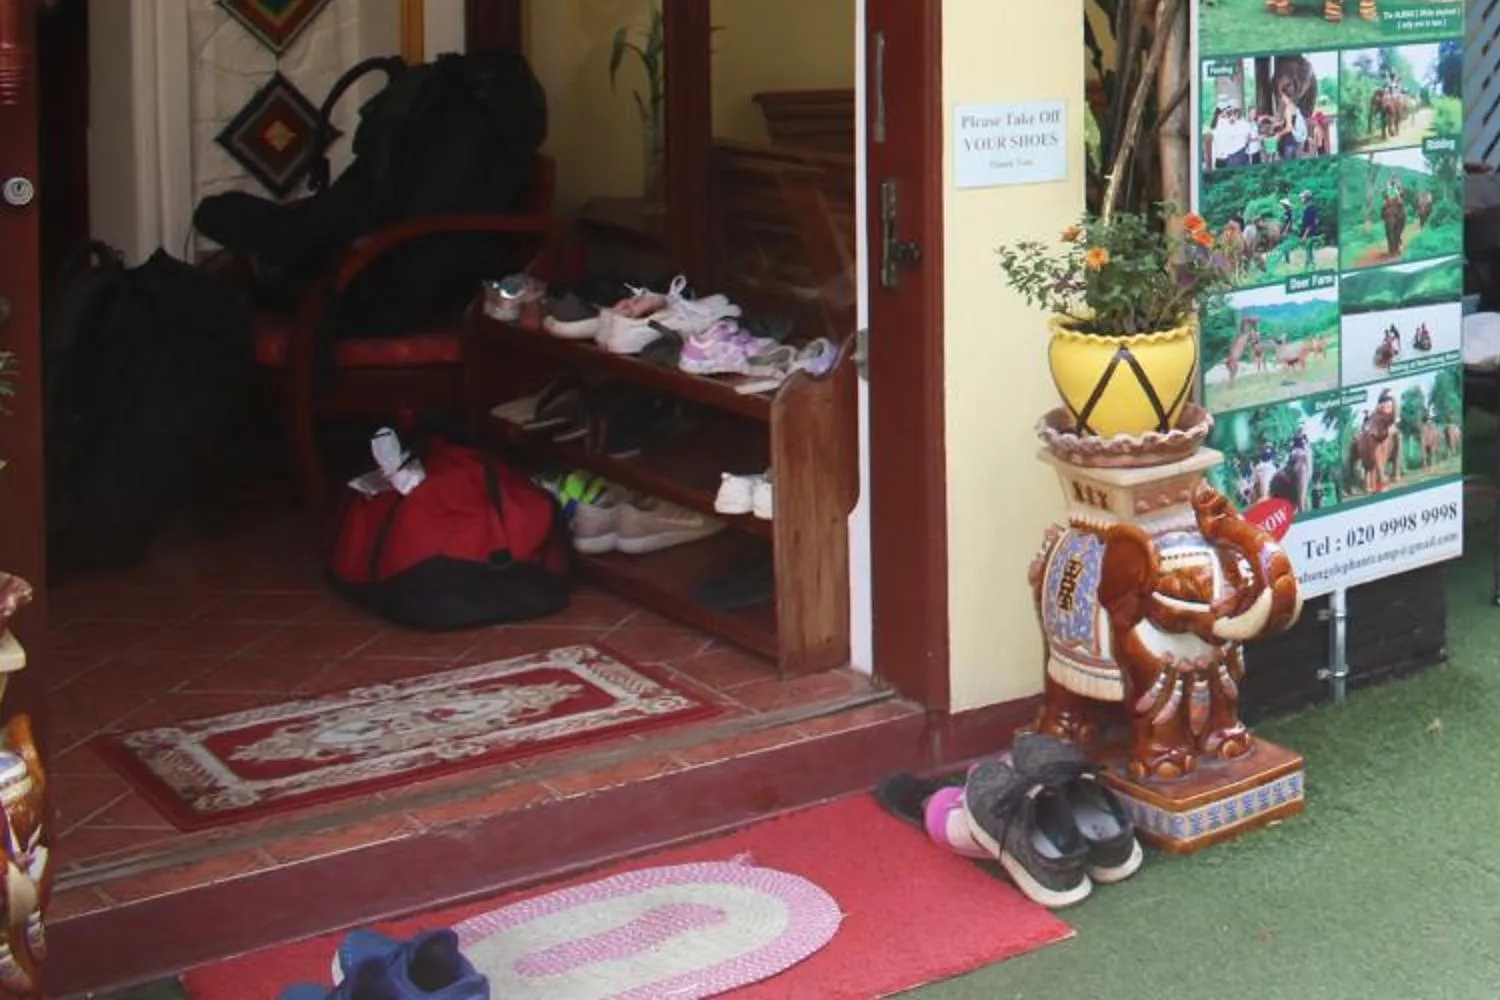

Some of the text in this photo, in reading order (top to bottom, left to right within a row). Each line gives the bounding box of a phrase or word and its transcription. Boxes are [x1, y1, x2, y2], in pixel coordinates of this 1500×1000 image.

[961, 114, 1000, 130] Please
[1007, 112, 1034, 126] Take
[964, 133, 1059, 152] YOUR SHOES
[1303, 535, 1330, 559] Tel
[1347, 526, 1375, 548] 020
[1421, 501, 1457, 525] 9998
